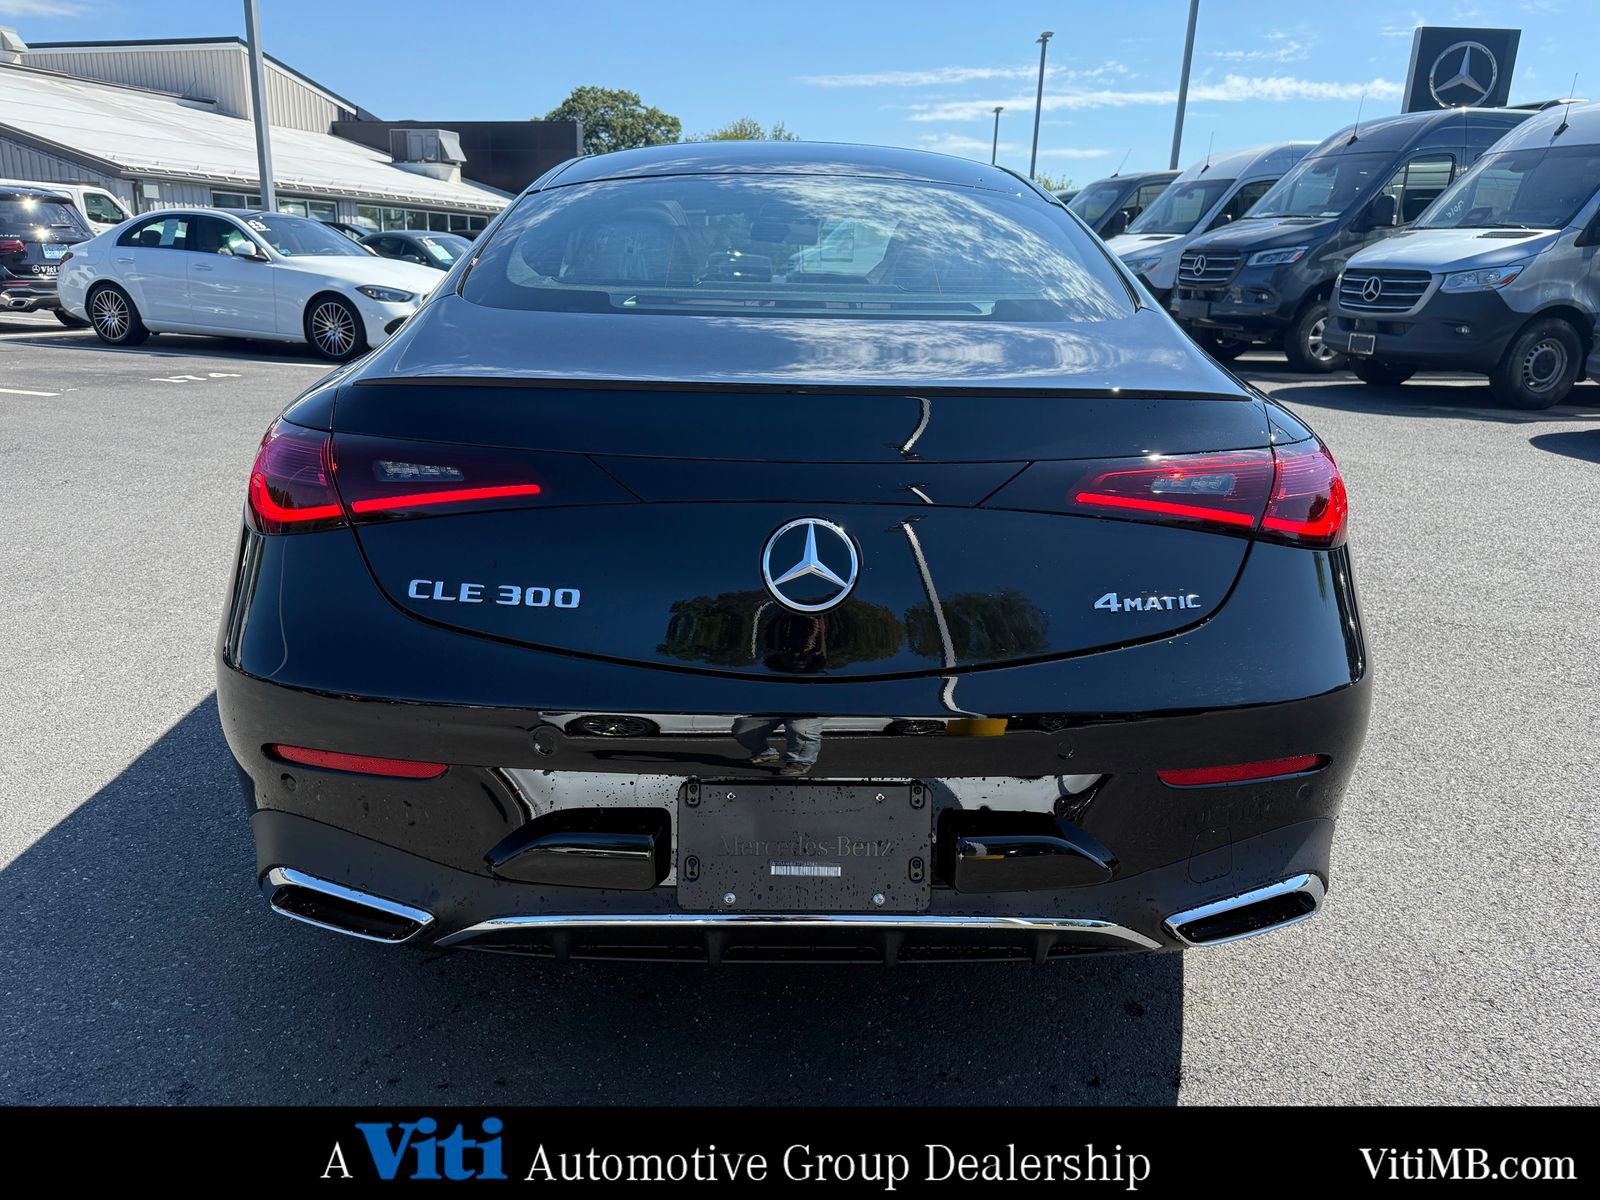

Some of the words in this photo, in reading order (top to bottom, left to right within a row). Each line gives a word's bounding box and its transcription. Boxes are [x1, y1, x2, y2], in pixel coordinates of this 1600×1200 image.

[408, 579, 485, 602] CLE
[496, 585, 581, 608] 300
[1094, 592, 1201, 612] 4MATIC
[717, 835, 894, 857] Mercedes-Benz
